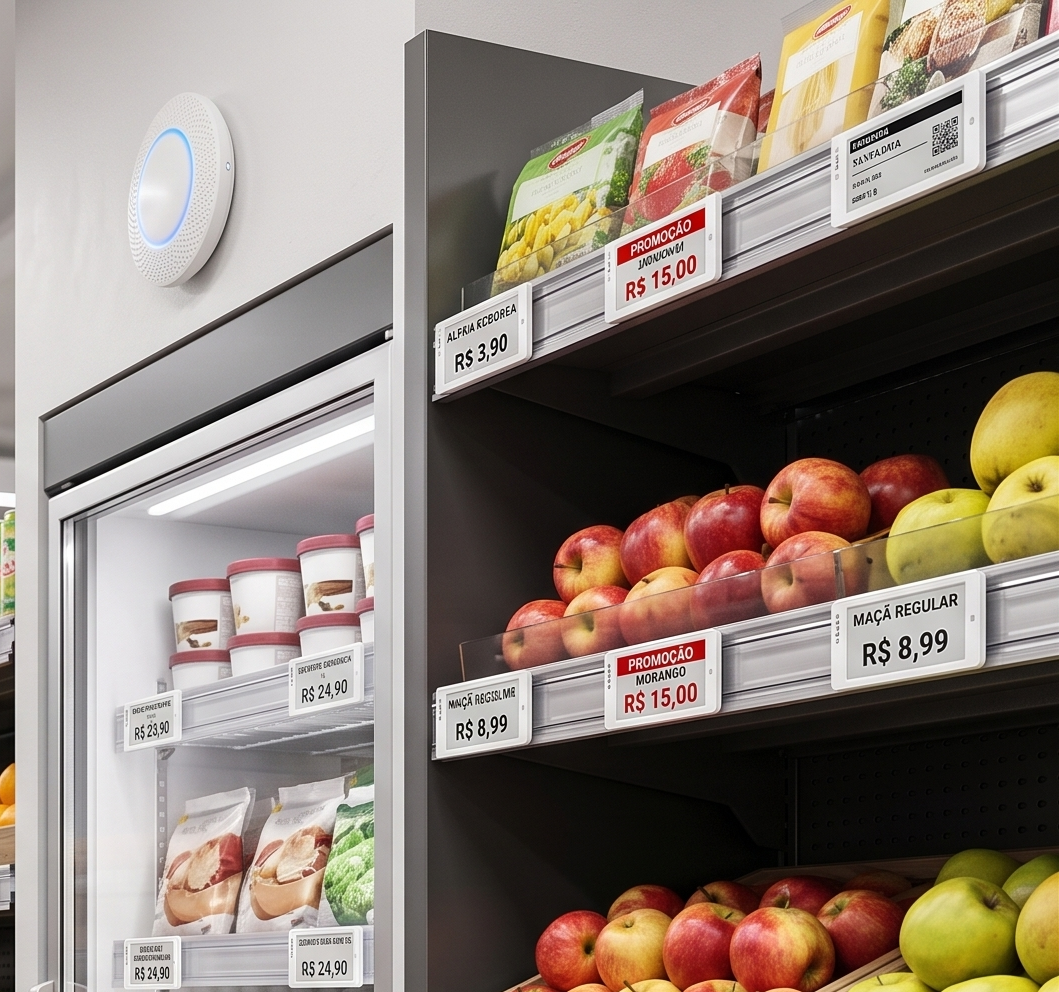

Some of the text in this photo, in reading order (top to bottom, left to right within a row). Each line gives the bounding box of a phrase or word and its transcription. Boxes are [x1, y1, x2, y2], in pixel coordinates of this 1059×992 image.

[630, 219, 692, 257] PROMOÇÃO
[626, 276, 646, 301] R$
[651, 254, 697, 289] 15,00
[455, 333, 508, 373] R$ 3,90
[853, 593, 958, 627] MAÇÃ REGULAR
[628, 645, 694, 672] PROMOÇÃO
[862, 629, 948, 667] R$ 8,99
[317, 678, 348, 700] 24,90
[636, 666, 686, 687] MORANGO
[624, 682, 698, 714] R$ 15,00
[456, 714, 508, 741] R$ 8,99
[147, 966, 170, 982] 24,90
[318, 959, 348, 979] 24,90
